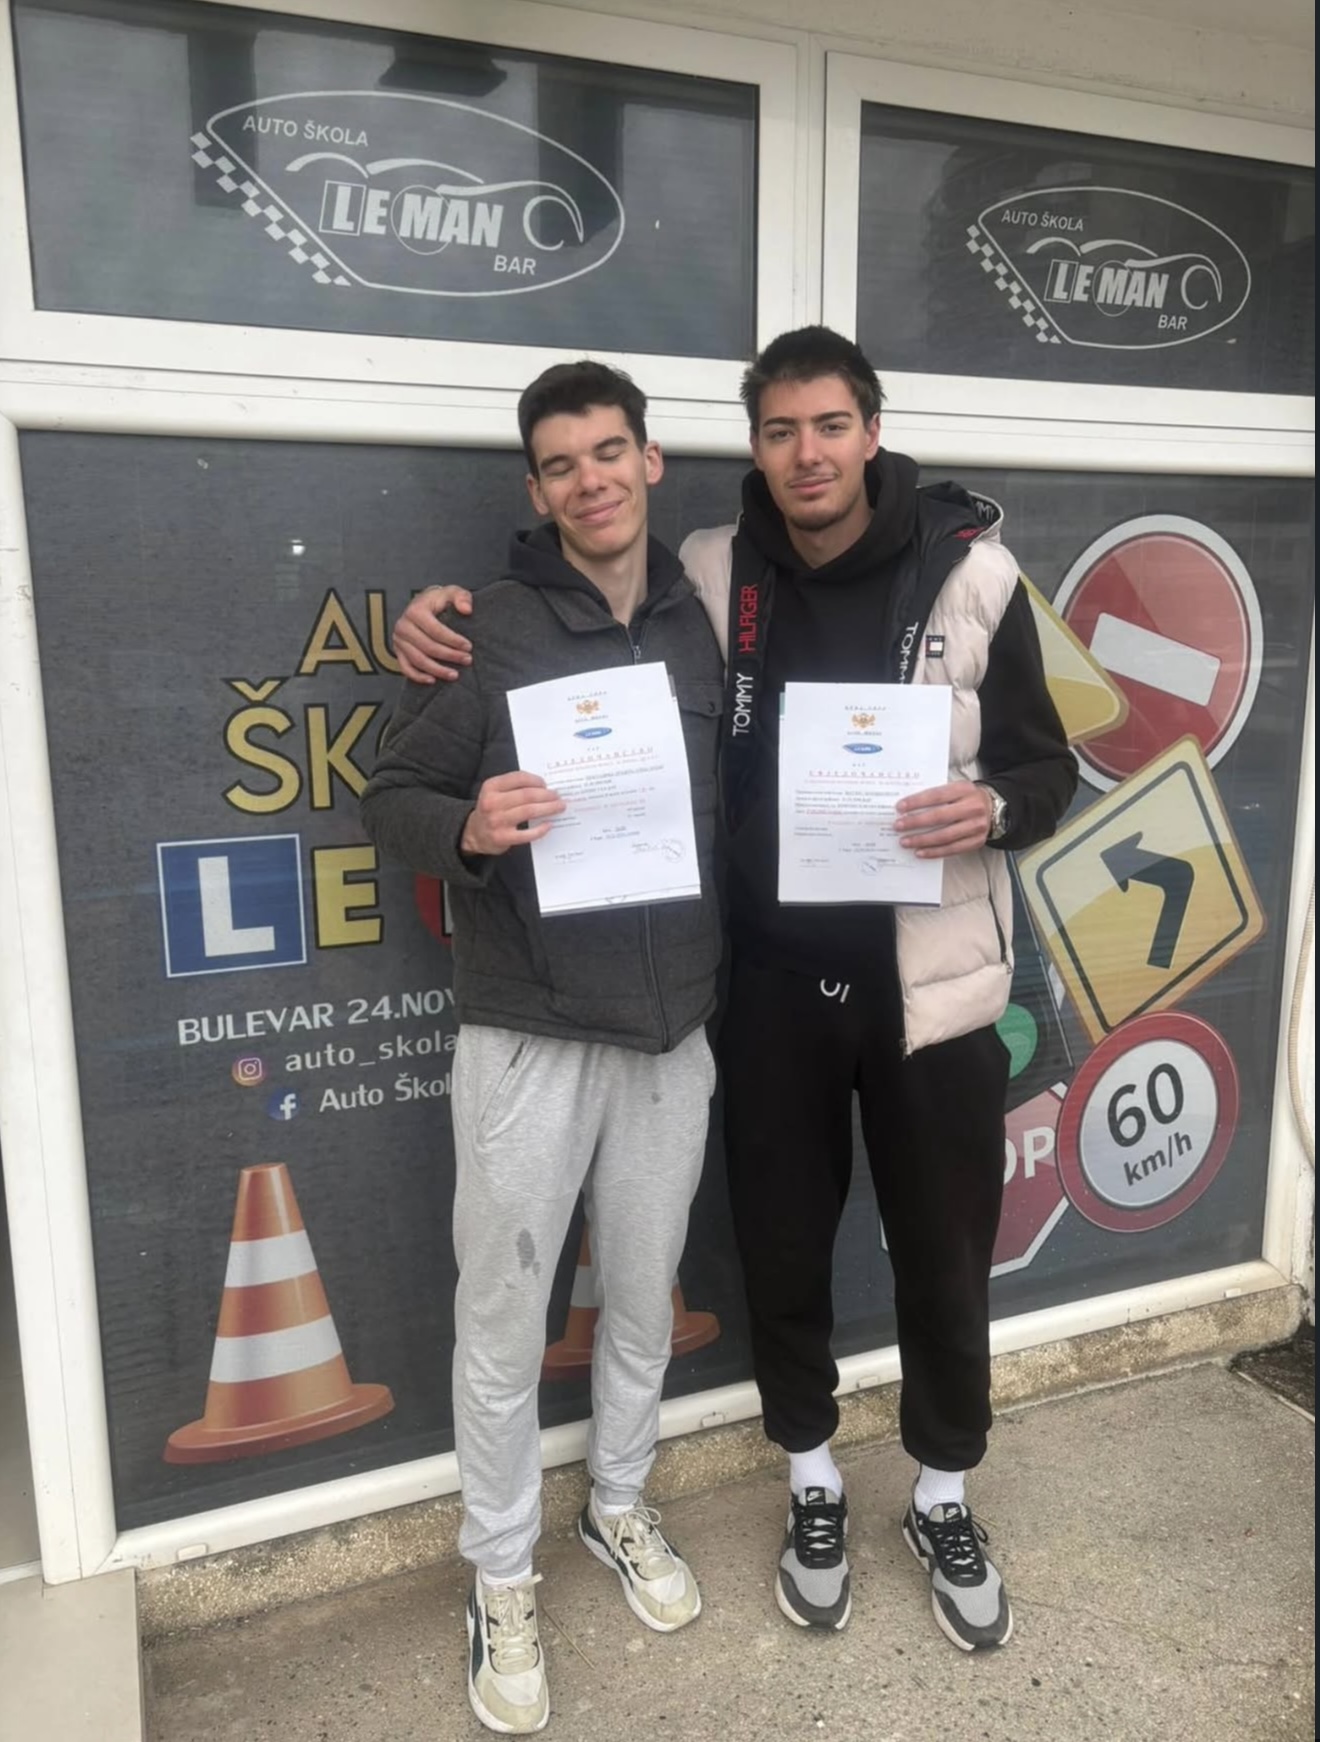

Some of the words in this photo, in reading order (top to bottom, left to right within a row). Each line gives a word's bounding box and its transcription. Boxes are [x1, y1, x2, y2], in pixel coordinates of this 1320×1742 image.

[242, 115, 299, 138] AUTO
[303, 119, 369, 147] ŠKOLA
[332, 185, 391, 236] LE
[399, 192, 504, 248] MAN
[1001, 209, 1038, 227] AUTO
[1040, 211, 1084, 231] ŠKOLA
[493, 254, 537, 275] BAR
[1053, 262, 1095, 301] LE
[1098, 267, 1170, 309] MAN
[1157, 314, 1188, 331] BAR
[739, 584, 758, 654] HILFIGER
[899, 621, 919, 686] TOMM
[732, 672, 754, 737] TOMMY
[221, 676, 393, 816] ŠK
[177, 1002, 335, 1046] BULEVAR
[284, 1030, 459, 1073] auto_skola
[319, 1083, 384, 1113] Auto
[394, 1072, 452, 1102] Škol
[1106, 1062, 1184, 1148] 60
[1123, 1132, 1193, 1187] km/h
